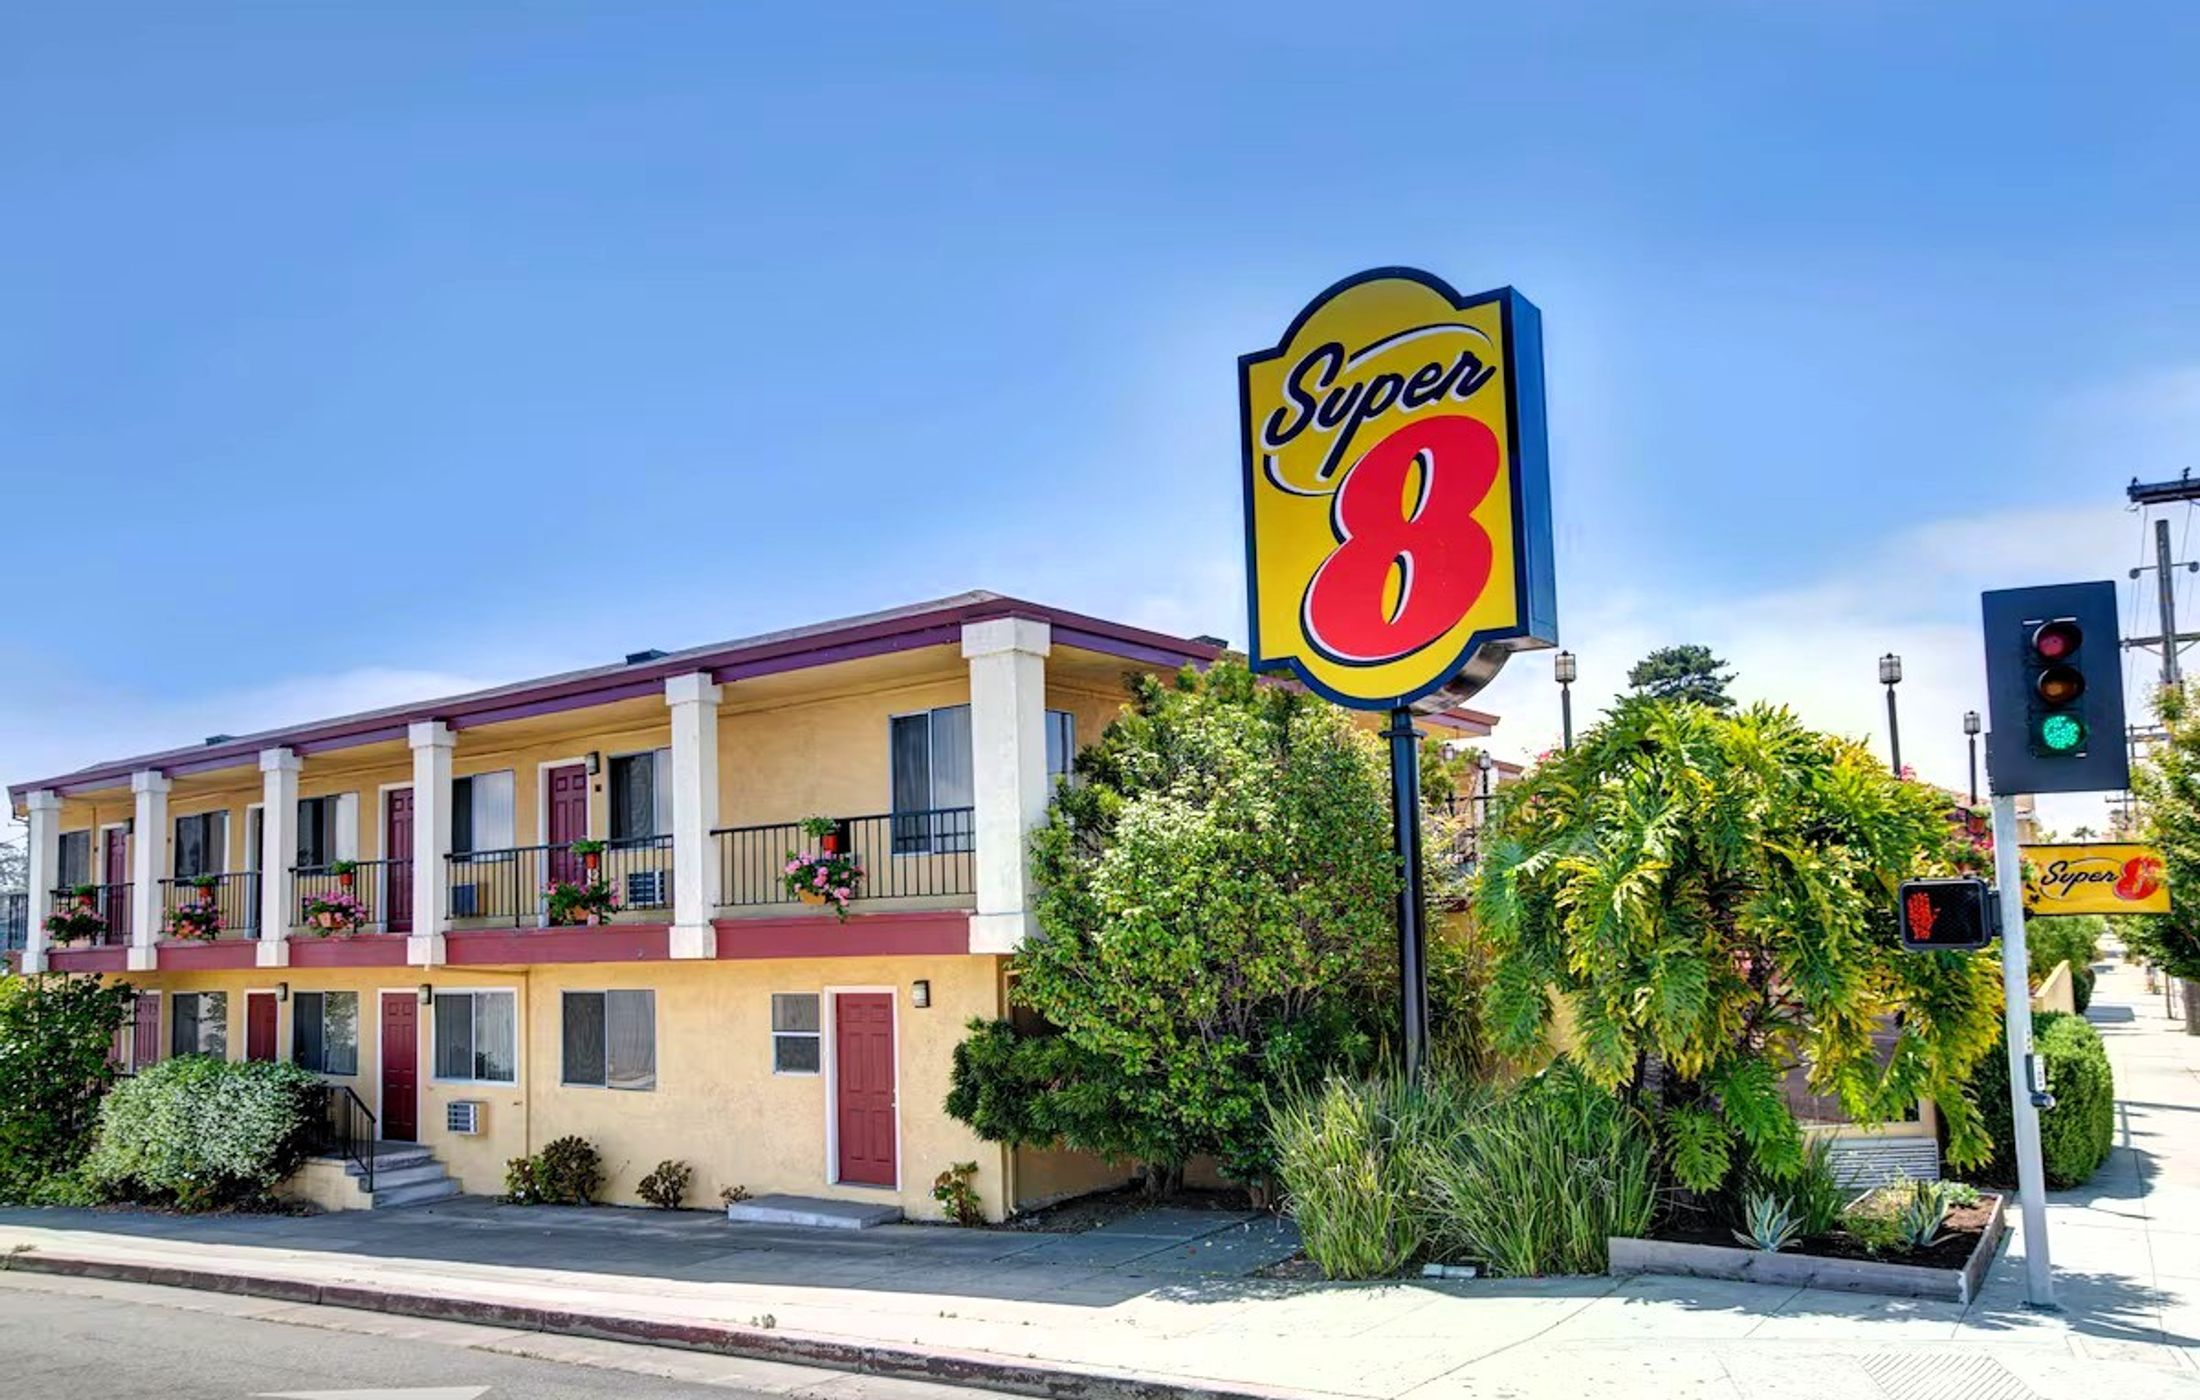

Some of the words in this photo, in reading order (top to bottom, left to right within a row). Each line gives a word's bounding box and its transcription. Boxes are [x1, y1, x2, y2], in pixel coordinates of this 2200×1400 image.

[1262, 341, 1497, 480] Super
[1300, 414, 1500, 667] 8
[2041, 860, 2118, 897] Super
[2114, 856, 2162, 901] 8
